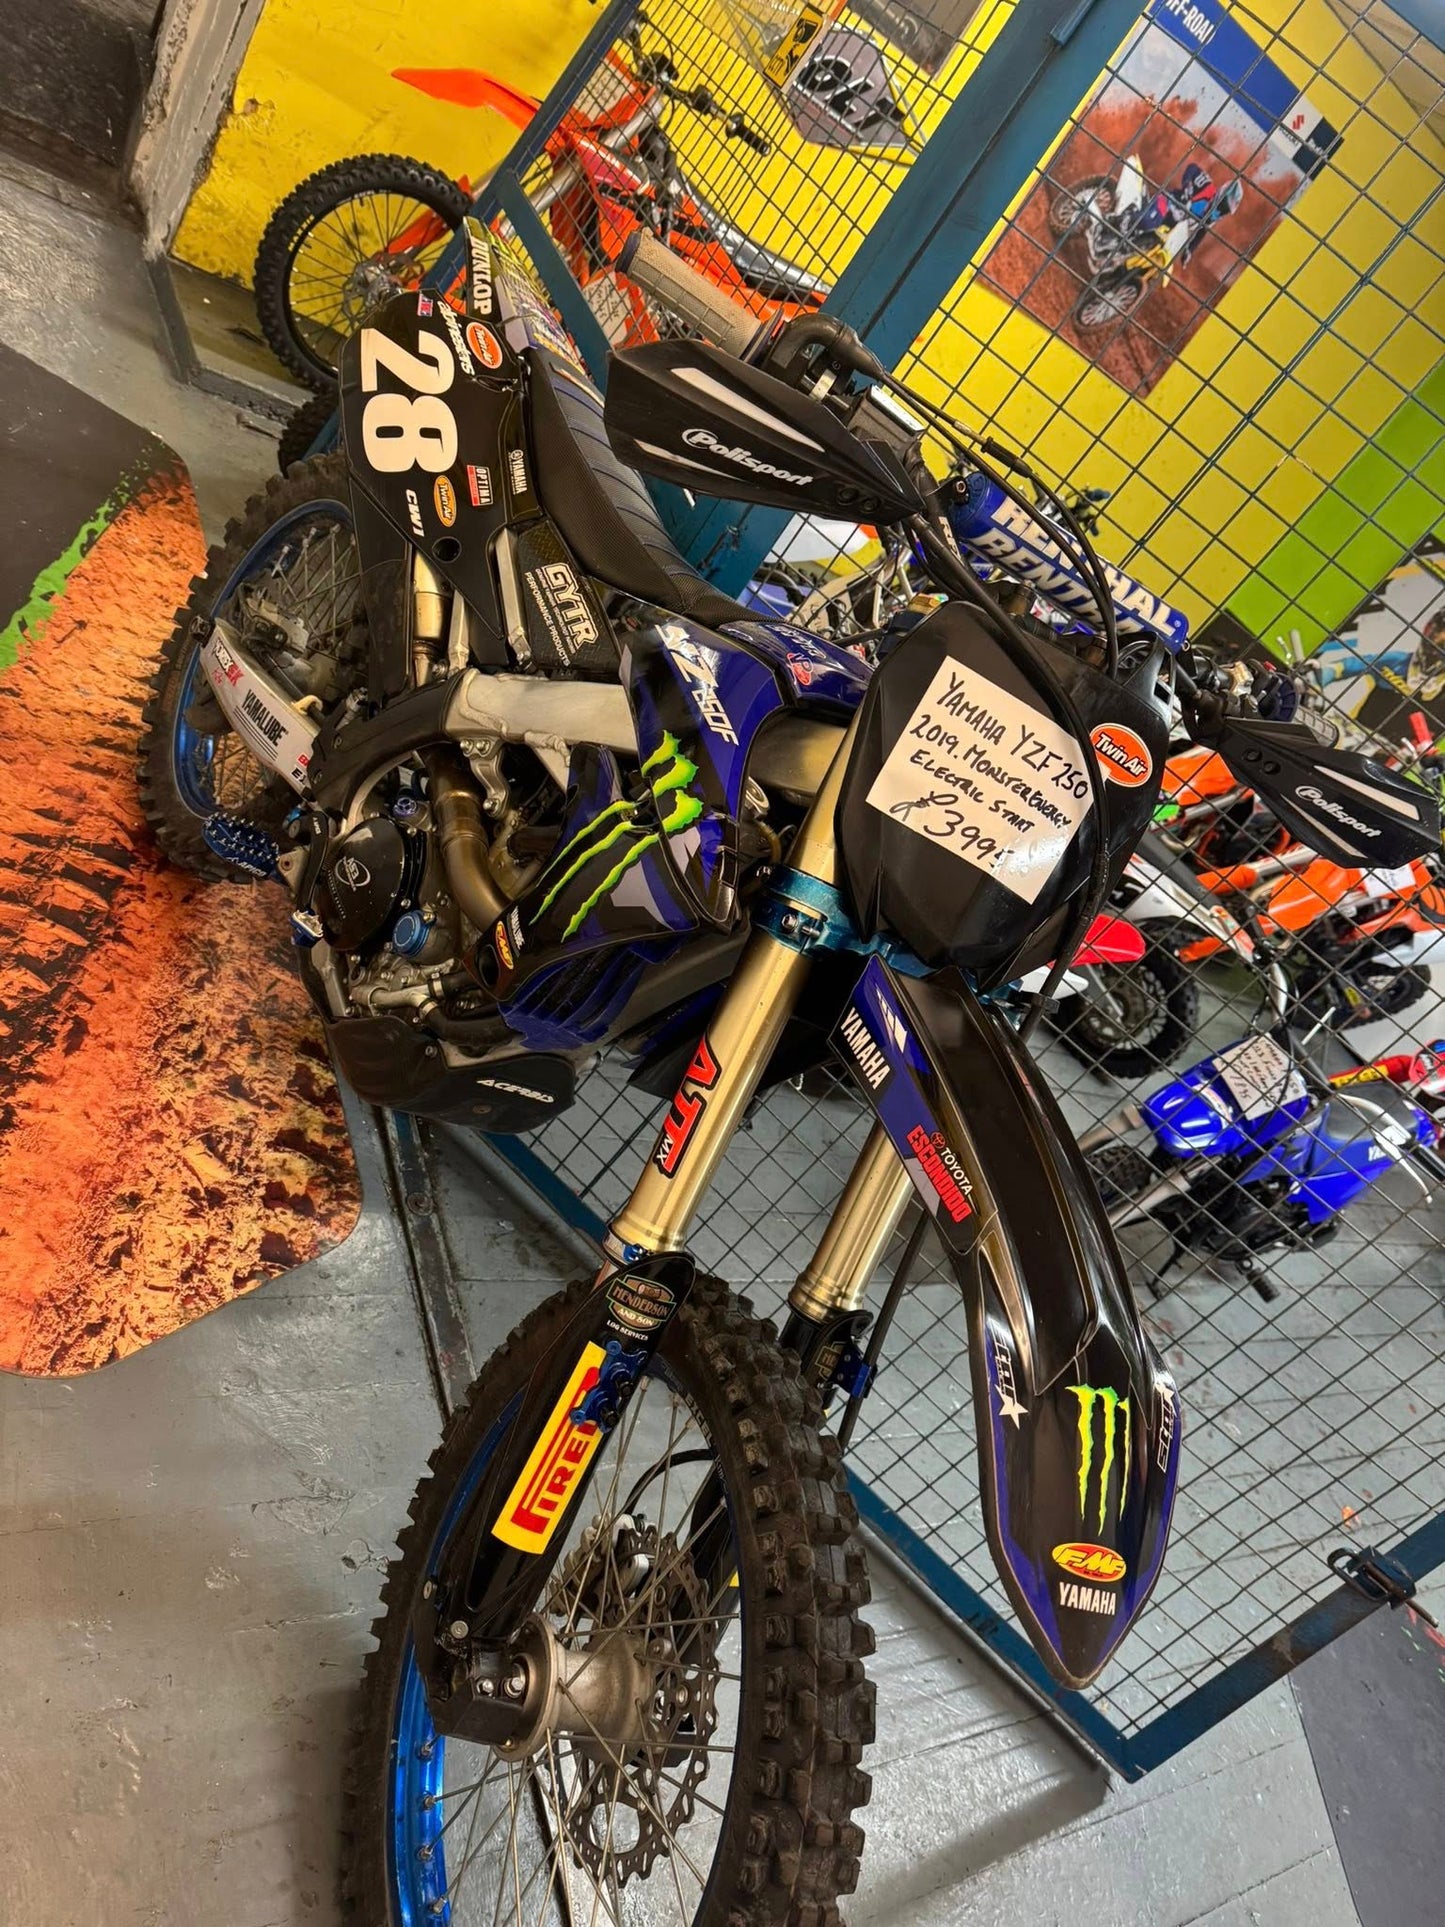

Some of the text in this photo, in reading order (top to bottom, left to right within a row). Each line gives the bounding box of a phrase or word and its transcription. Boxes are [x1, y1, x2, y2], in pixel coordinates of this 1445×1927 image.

[470, 235, 493, 315] DUNLOP
[360, 327, 459, 474] 28
[512, 457, 528, 495] YAMAHA
[681, 428, 814, 486] Polisport
[437, 482, 453, 520] Twin Air
[475, 467, 492, 504] OPTIMA
[524, 571, 571, 667] PERFORMANCE PRODUCTS
[541, 562, 599, 650] GYTR
[241, 688, 288, 747] YAMALUBE
[937, 671, 1008, 746] YAMAHA
[1094, 732, 1149, 778] Twin Air
[909, 749, 1036, 834] ELECTRIC START
[1294, 785, 1383, 838] Polisport
[839, 1006, 892, 1090] YAMAHA
[656, 1133, 675, 1165] MX
[906, 1124, 973, 1224] ESCONDIDO
[940, 1147, 974, 1197] TOYOTA
[612, 1286, 671, 1318] HENDERSON
[617, 1307, 655, 1327] AND SON
[606, 1319, 649, 1341] LOG SERVICES
[684, 1392, 713, 1449] EXCEL
[1056, 1546, 1126, 1579] FMF
[1059, 1581, 1117, 1616] YAMAHA
